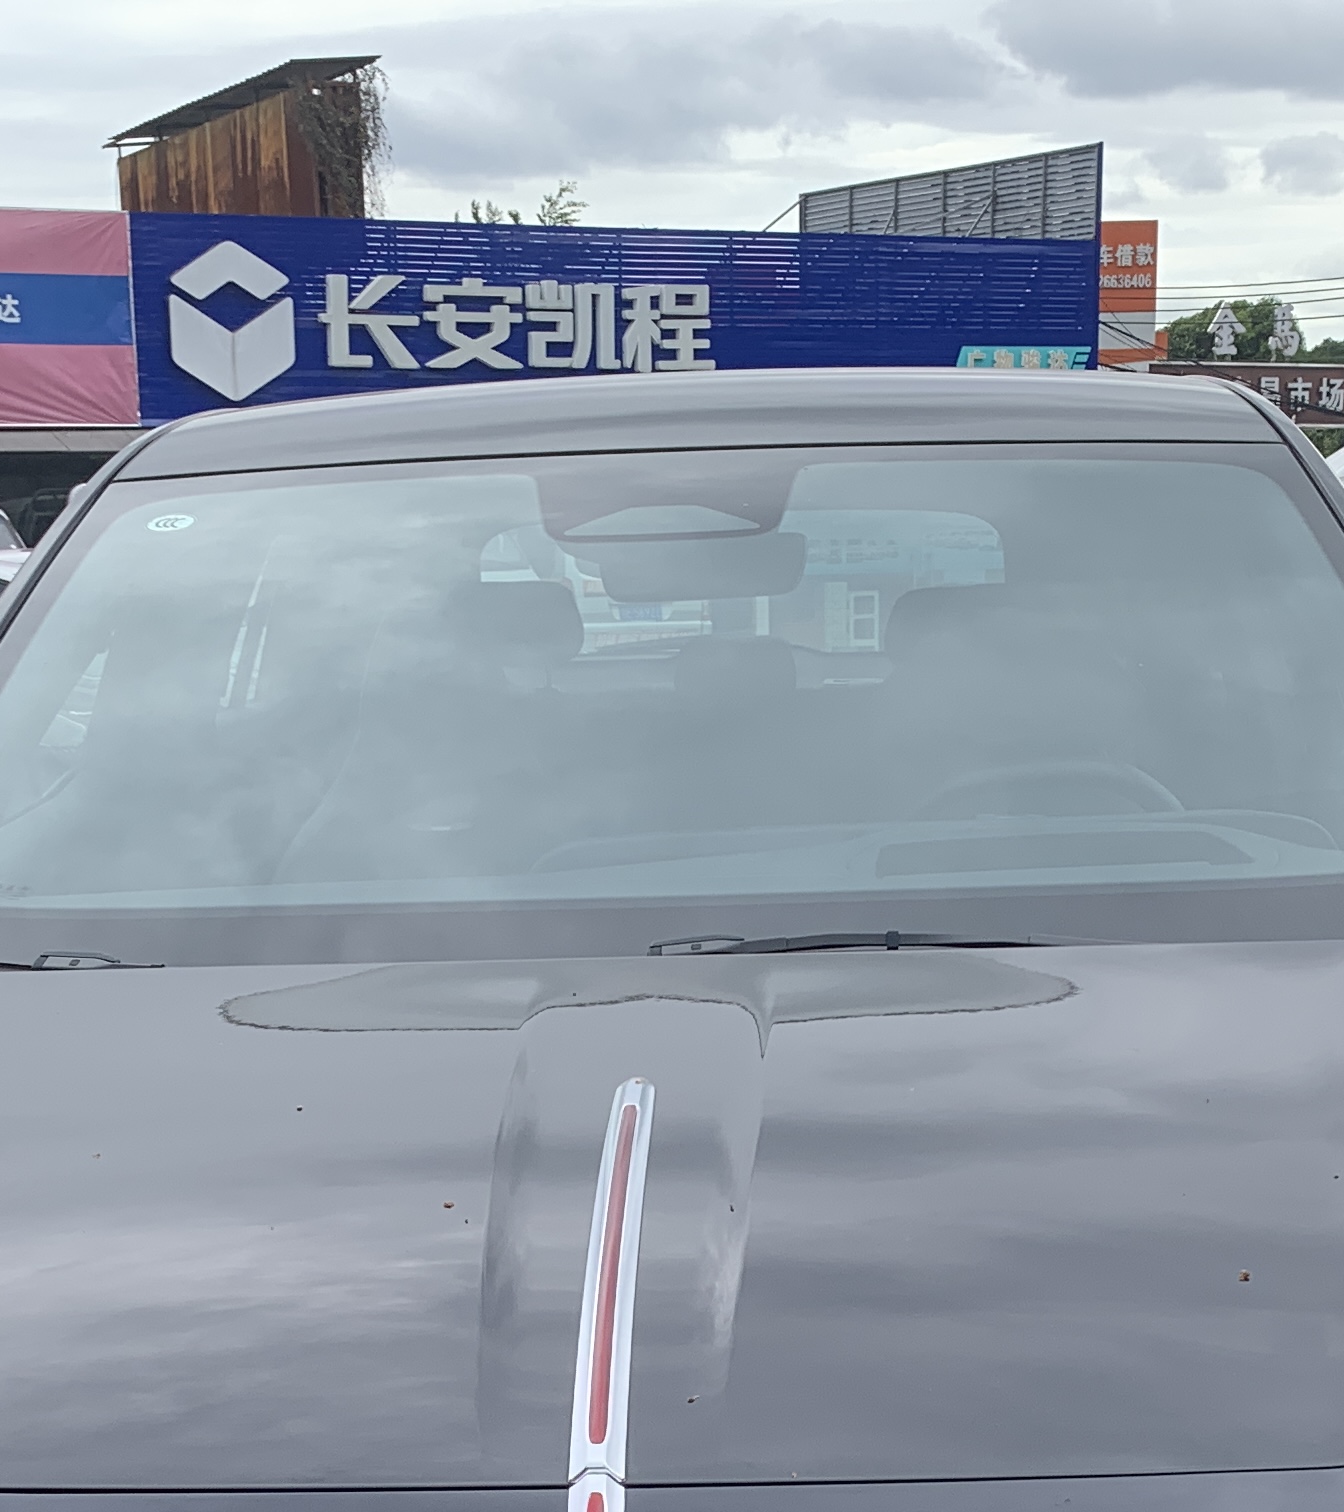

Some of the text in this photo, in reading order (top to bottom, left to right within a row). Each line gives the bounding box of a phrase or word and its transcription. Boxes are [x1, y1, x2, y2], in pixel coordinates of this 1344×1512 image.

[318, 274, 716, 372] 长安凯程
[1235, 375, 1344, 412] 易市场
